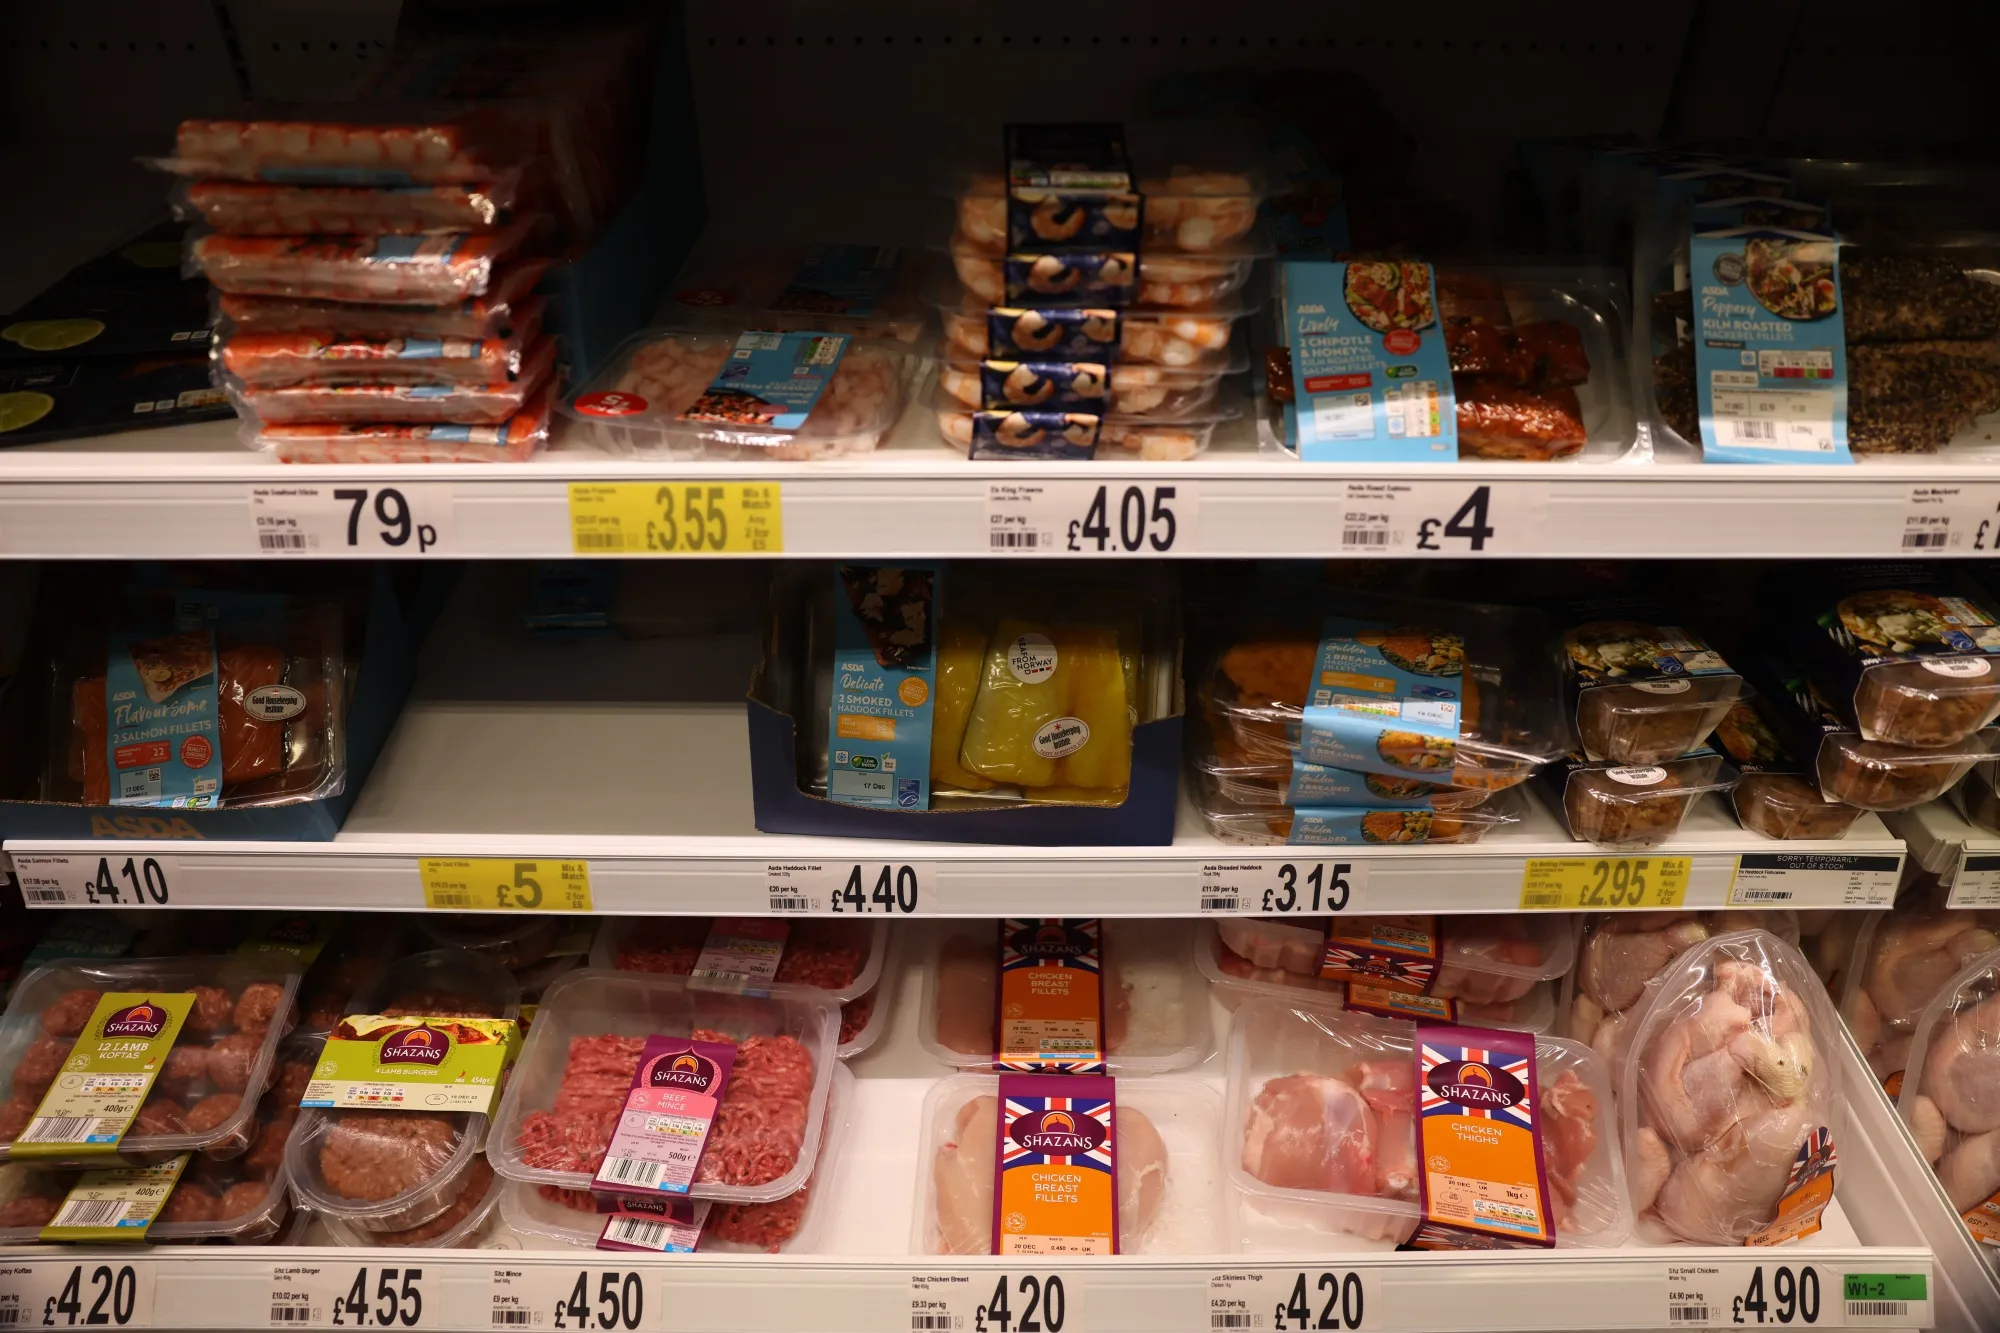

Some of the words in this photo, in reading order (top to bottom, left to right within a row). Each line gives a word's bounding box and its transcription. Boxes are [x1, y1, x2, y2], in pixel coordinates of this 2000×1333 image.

[1703, 297, 1756, 317] Peppery
[1298, 317, 1340, 333] Lively
[1704, 319, 1732, 330] KILN
[1734, 321, 1792, 332] ROASTED
[1309, 336, 1373, 347] CHIPOTLE
[1312, 348, 1357, 358] HONEY
[742, 499, 771, 510] Match
[333, 487, 437, 553] 79p
[646, 486, 728, 551] £3.55
[1067, 486, 1177, 551] £4.05
[1416, 486, 1494, 551] £4
[1012, 655, 1037, 666] FROM
[1017, 657, 1053, 671] NORWAY
[1333, 654, 1388, 666] BREADED
[841, 663, 865, 672] ASDA
[840, 673, 885, 692] Delicate
[112, 690, 137, 702] ASDA
[838, 694, 845, 703] 2
[846, 695, 893, 707] SMOKED
[837, 704, 882, 717] HADDOCK
[883, 708, 915, 717] FILLETS
[113, 734, 120, 744] 2
[120, 724, 168, 742] SALMON
[169, 719, 212, 736] FILLETS
[152, 747, 165, 758] 22
[1300, 825, 1332, 834] Golden
[562, 864, 575, 872] Mix
[577, 864, 584, 872] &
[1662, 860, 1675, 868] Mix
[562, 872, 585, 880] Match
[1659, 868, 1683, 877] Match
[85, 857, 169, 905] £4.10
[497, 863, 543, 908] £5
[1579, 860, 1649, 907] £2.95
[790, 886, 798, 894] kg
[831, 865, 918, 913] £4.40
[1202, 885, 1220, 893] £11.09
[1231, 886, 1239, 894] kg
[1262, 863, 1351, 912] £3.15
[1664, 889, 1676, 897] for
[566, 892, 572, 900] 2
[573, 892, 585, 900] for
[1660, 897, 1671, 905] £5
[1028, 972, 1073, 980] CHICKEN
[1031, 980, 1070, 988] BREAST
[1031, 988, 1070, 996] FILLETS
[107, 1022, 160, 1033] SHAZANS
[97, 1042, 110, 1051] 12
[112, 1042, 149, 1051] LAMB
[99, 1051, 140, 1060] KOFTAS
[384, 1047, 441, 1060] SHAZANS
[471, 1076, 487, 1084] 454g
[654, 1071, 708, 1087] SHAZANS
[662, 1093, 687, 1102] BEEF
[1440, 1085, 1512, 1106] SHAZANS
[103, 1103, 125, 1114] 400g
[657, 1101, 686, 1111] MINCE
[1451, 1122, 1503, 1137] CHICKEN
[1023, 1134, 1093, 1150] SHAZANS
[1456, 1132, 1500, 1145] THIGHS
[668, 1151, 688, 1161] 500g
[1031, 1173, 1082, 1183] CHICKEN
[134, 1187, 155, 1197] 400g
[1034, 1183, 1079, 1193] BREAST
[1035, 1193, 1078, 1203] FILLETS
[1506, 1190, 1519, 1200] 1kg
[626, 1201, 664, 1212] SHAZANS
[1733, 1266, 1820, 1324] £4.90
[1848, 1282, 1885, 1297] W1-2
[1, 1295, 11, 1303] per
[12, 1293, 19, 1302] kg
[43, 1265, 136, 1326] £4.20
[272, 1292, 291, 1300] £10.02
[291, 1294, 301, 1302] per
[301, 1292, 309, 1301] kg
[333, 1267, 422, 1327] £4.55
[493, 1295, 501, 1303] £9
[511, 1295, 519, 1304] kg
[555, 1271, 643, 1330] £4.50
[1669, 1291, 1685, 1300] £4.90
[1695, 1292, 1703, 1301] kg
[912, 1300, 927, 1309] £9.33
[928, 1302, 938, 1310] per
[938, 1301, 947, 1310] kg
[976, 1275, 1065, 1333] £4.20
[1227, 1301, 1237, 1309] per
[1237, 1299, 1246, 1309] kg
[1275, 1272, 1364, 1331] £4.20
